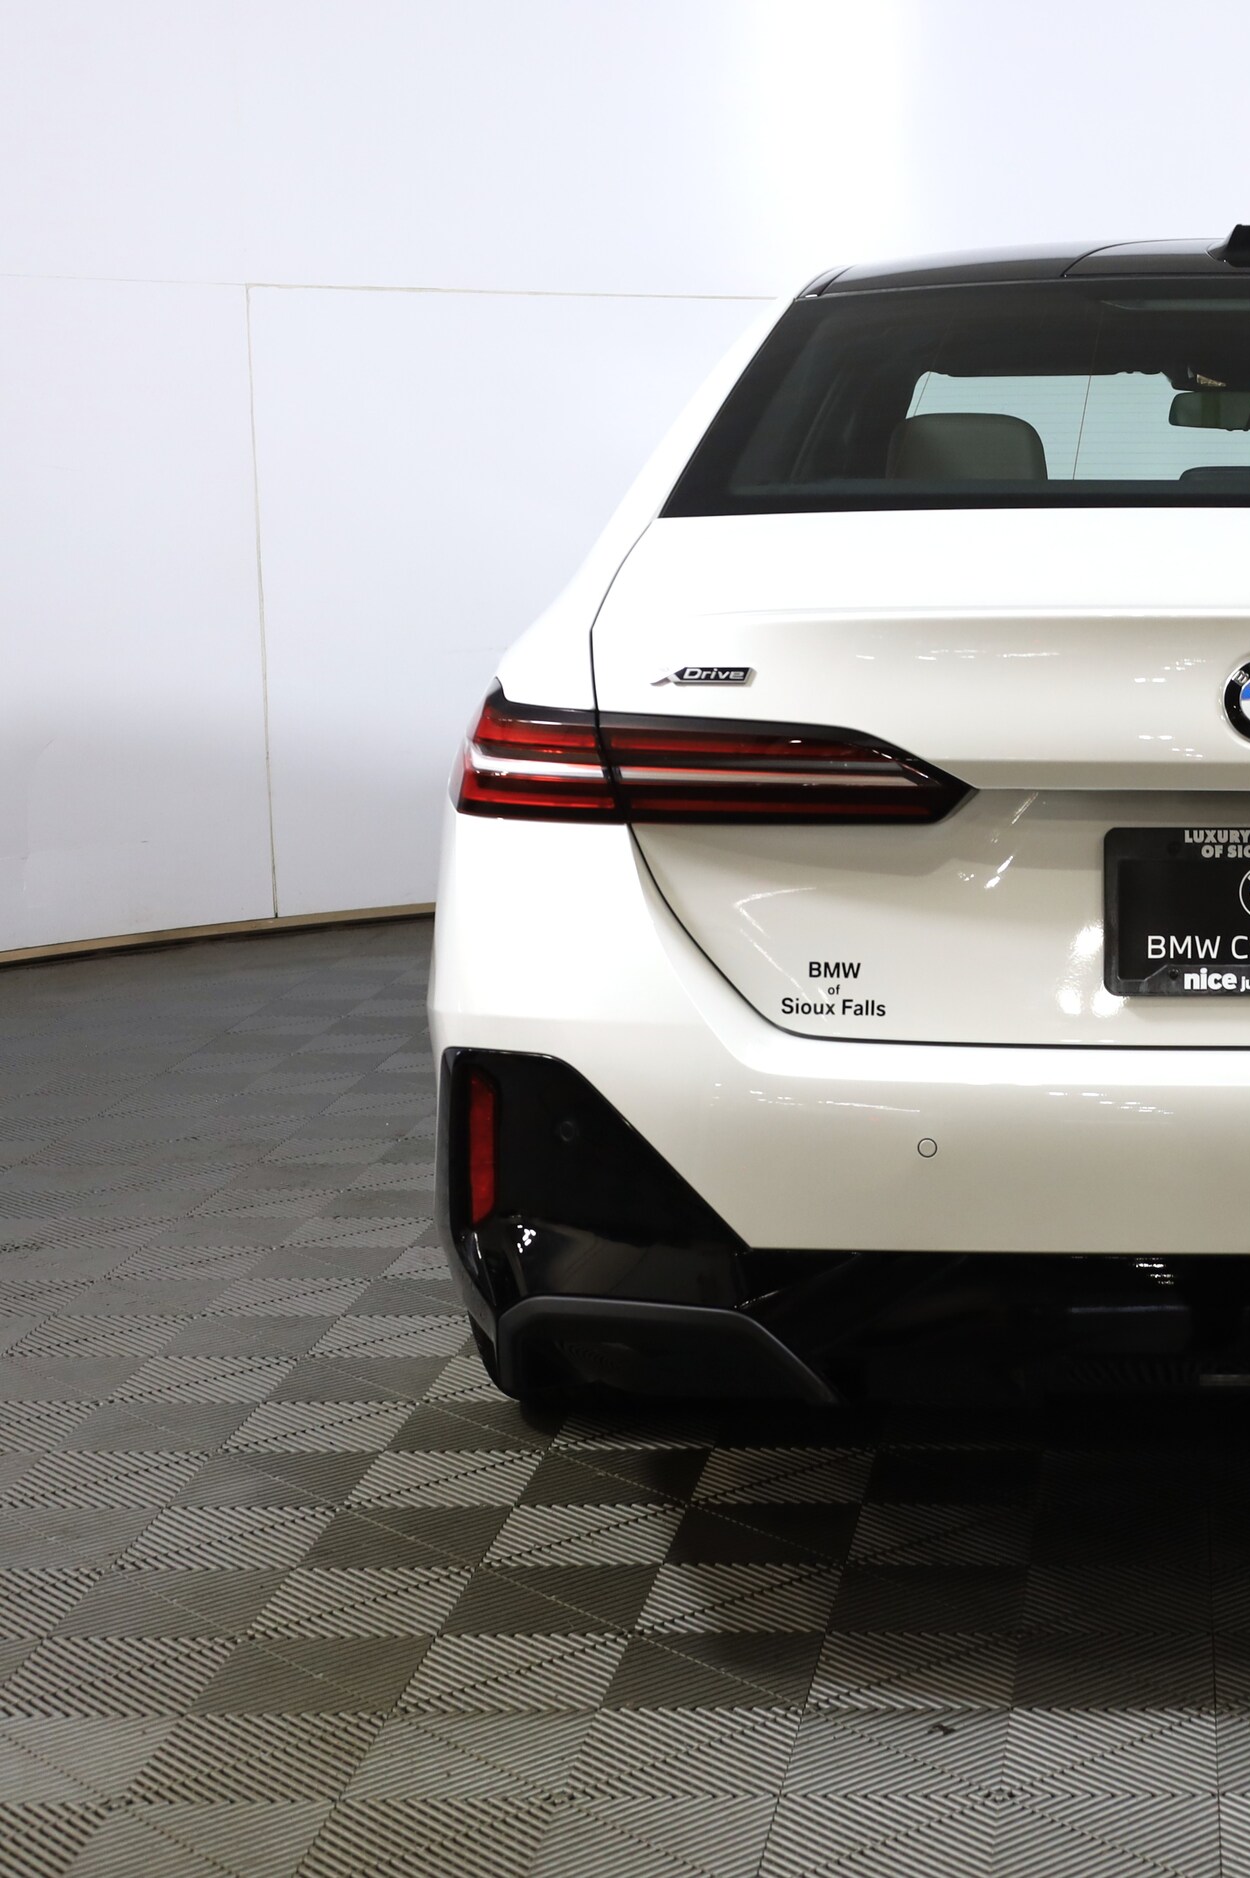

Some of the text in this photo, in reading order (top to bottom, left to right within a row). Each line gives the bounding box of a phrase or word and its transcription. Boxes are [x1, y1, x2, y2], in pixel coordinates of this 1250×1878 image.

[1201, 844, 1224, 859] OF
[1147, 935, 1221, 959] BMW
[808, 961, 862, 979] BMW
[1183, 967, 1238, 991] nice
[827, 983, 841, 996] of
[781, 997, 886, 1017] Sioux Falls
